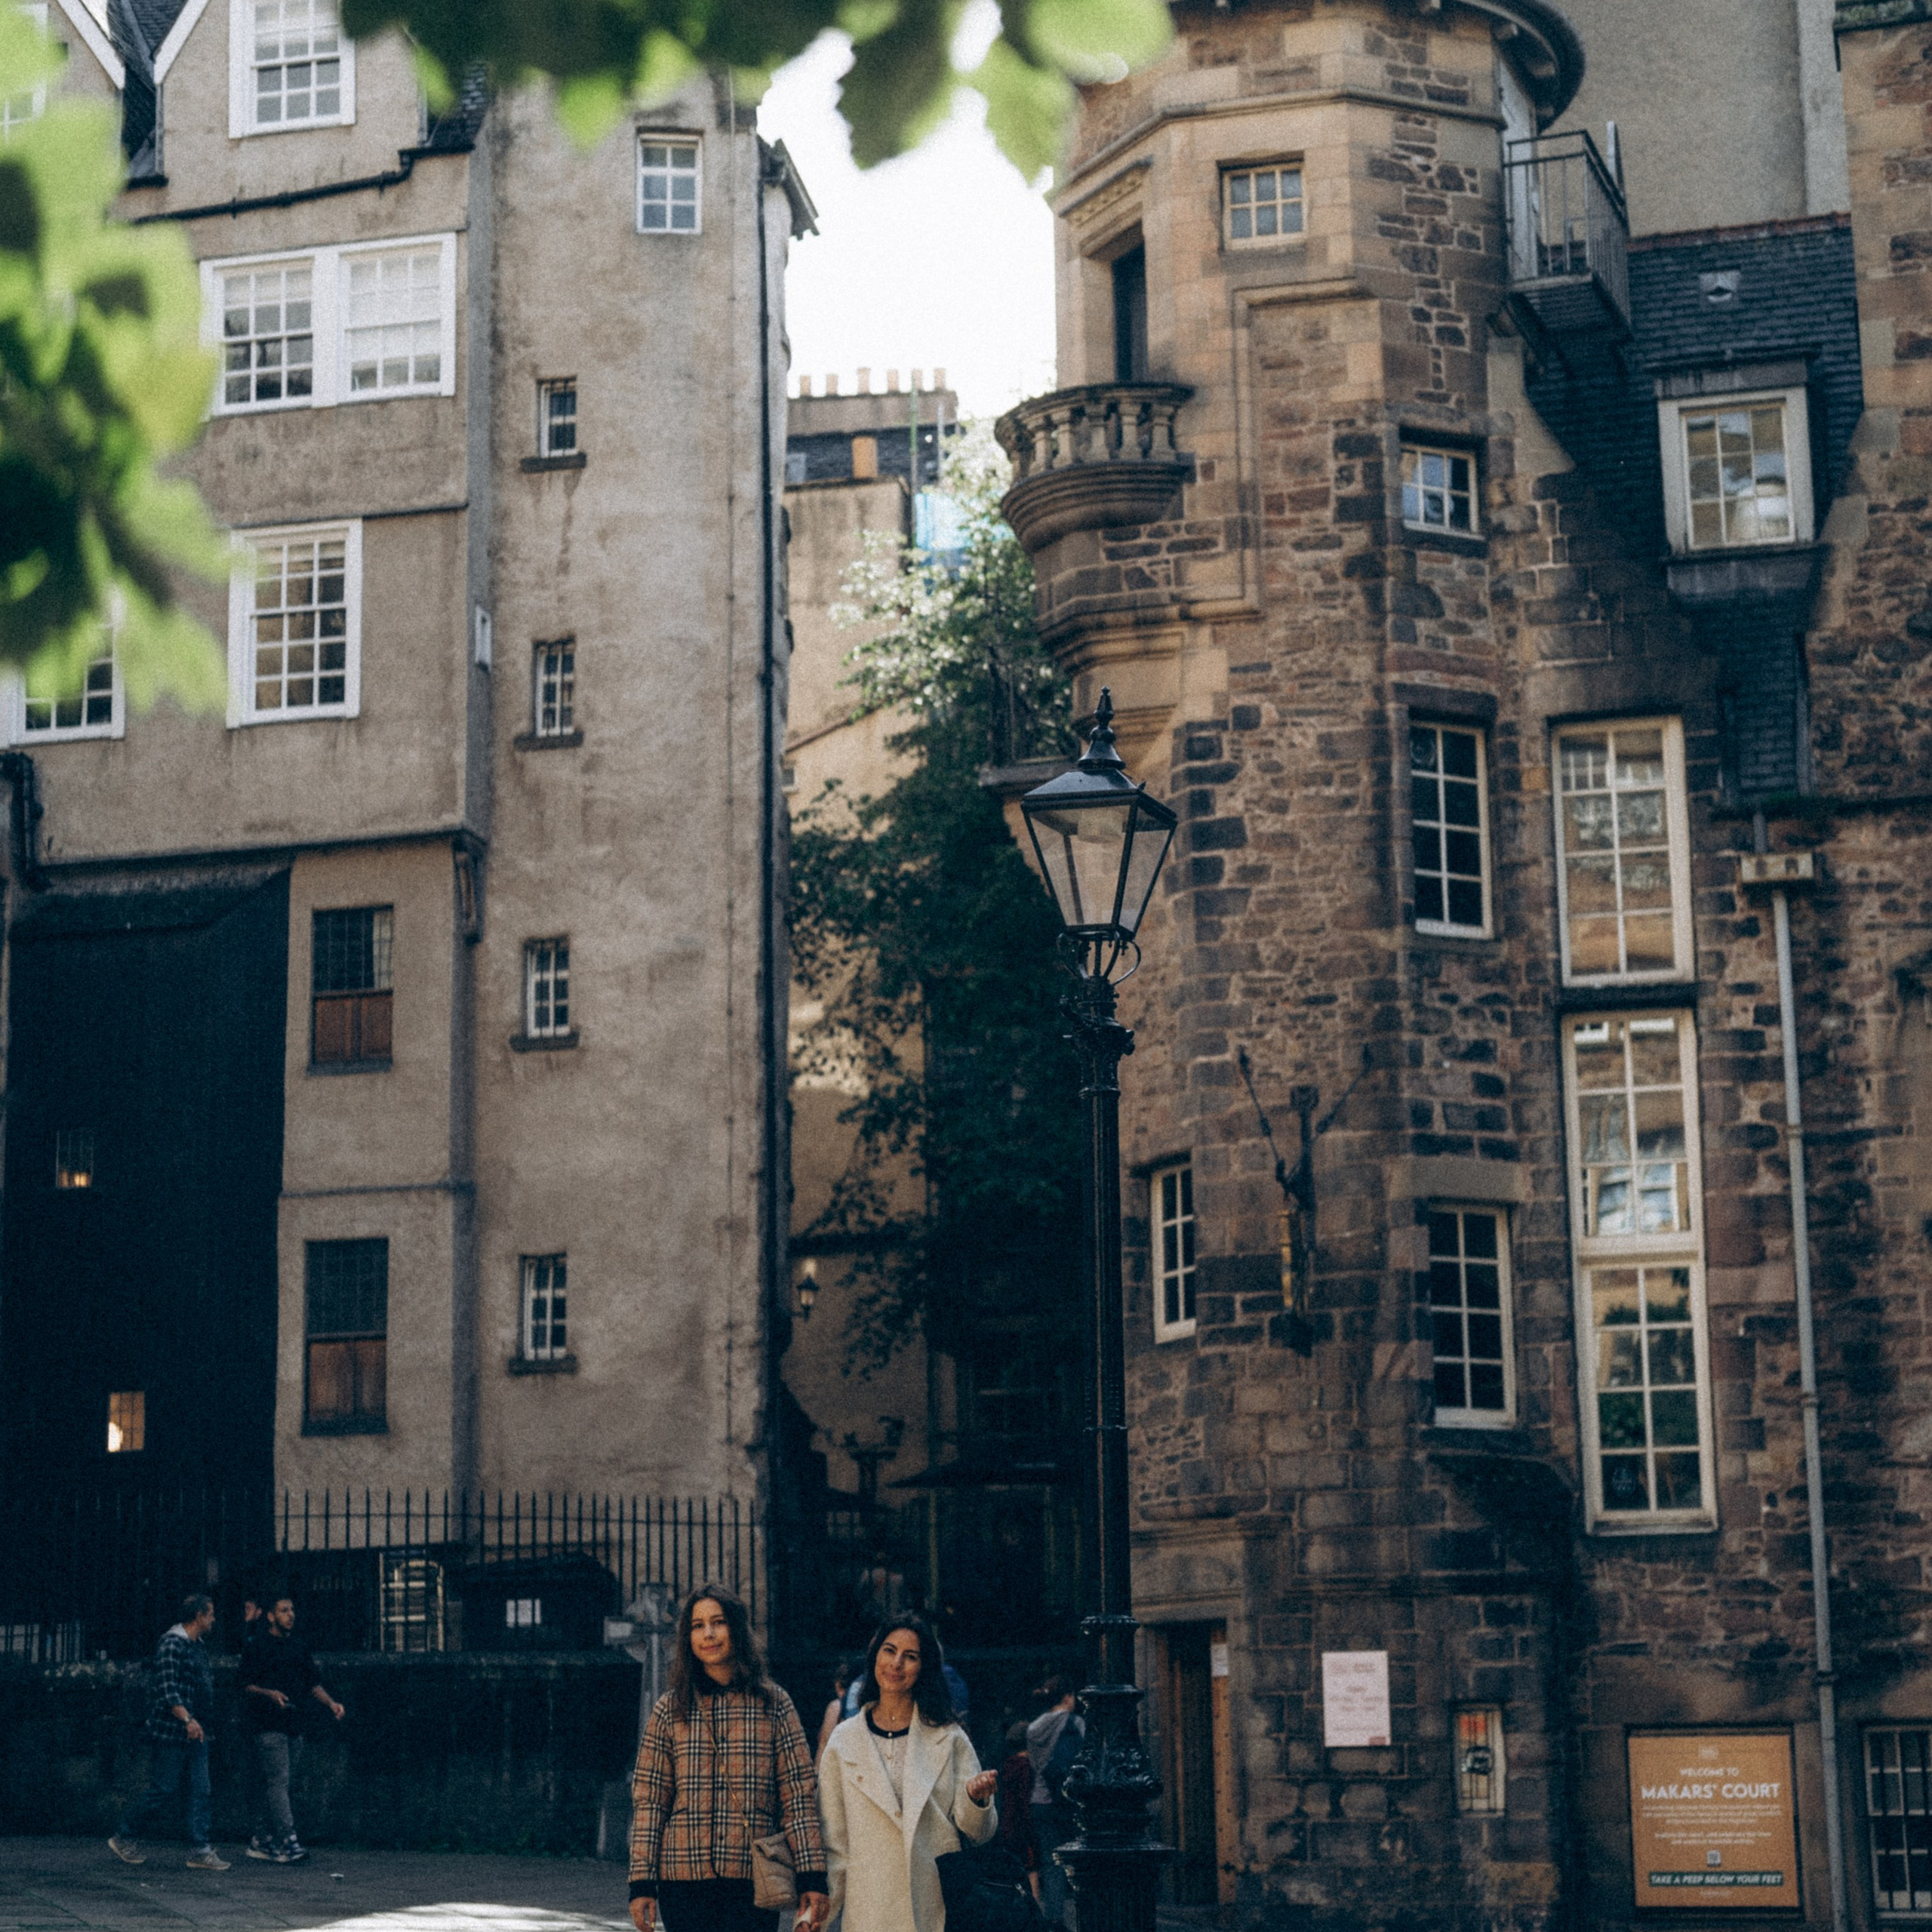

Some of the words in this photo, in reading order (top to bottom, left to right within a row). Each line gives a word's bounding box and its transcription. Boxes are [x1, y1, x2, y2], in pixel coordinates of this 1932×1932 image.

[1679, 1767, 1724, 1777] WELCOME
[1727, 1767, 1740, 1776] TO
[1641, 1783, 1717, 1799] MAKARS'
[1721, 1782, 1780, 1798] COURT
[1651, 1875, 1672, 1884] TAKE
[1673, 1875, 1681, 1884] A
[1682, 1875, 1703, 1884] PEEP
[1705, 1875, 1734, 1884] BELOW
[1737, 1874, 1759, 1883] YOUR
[1761, 1874, 1782, 1883] FEET
